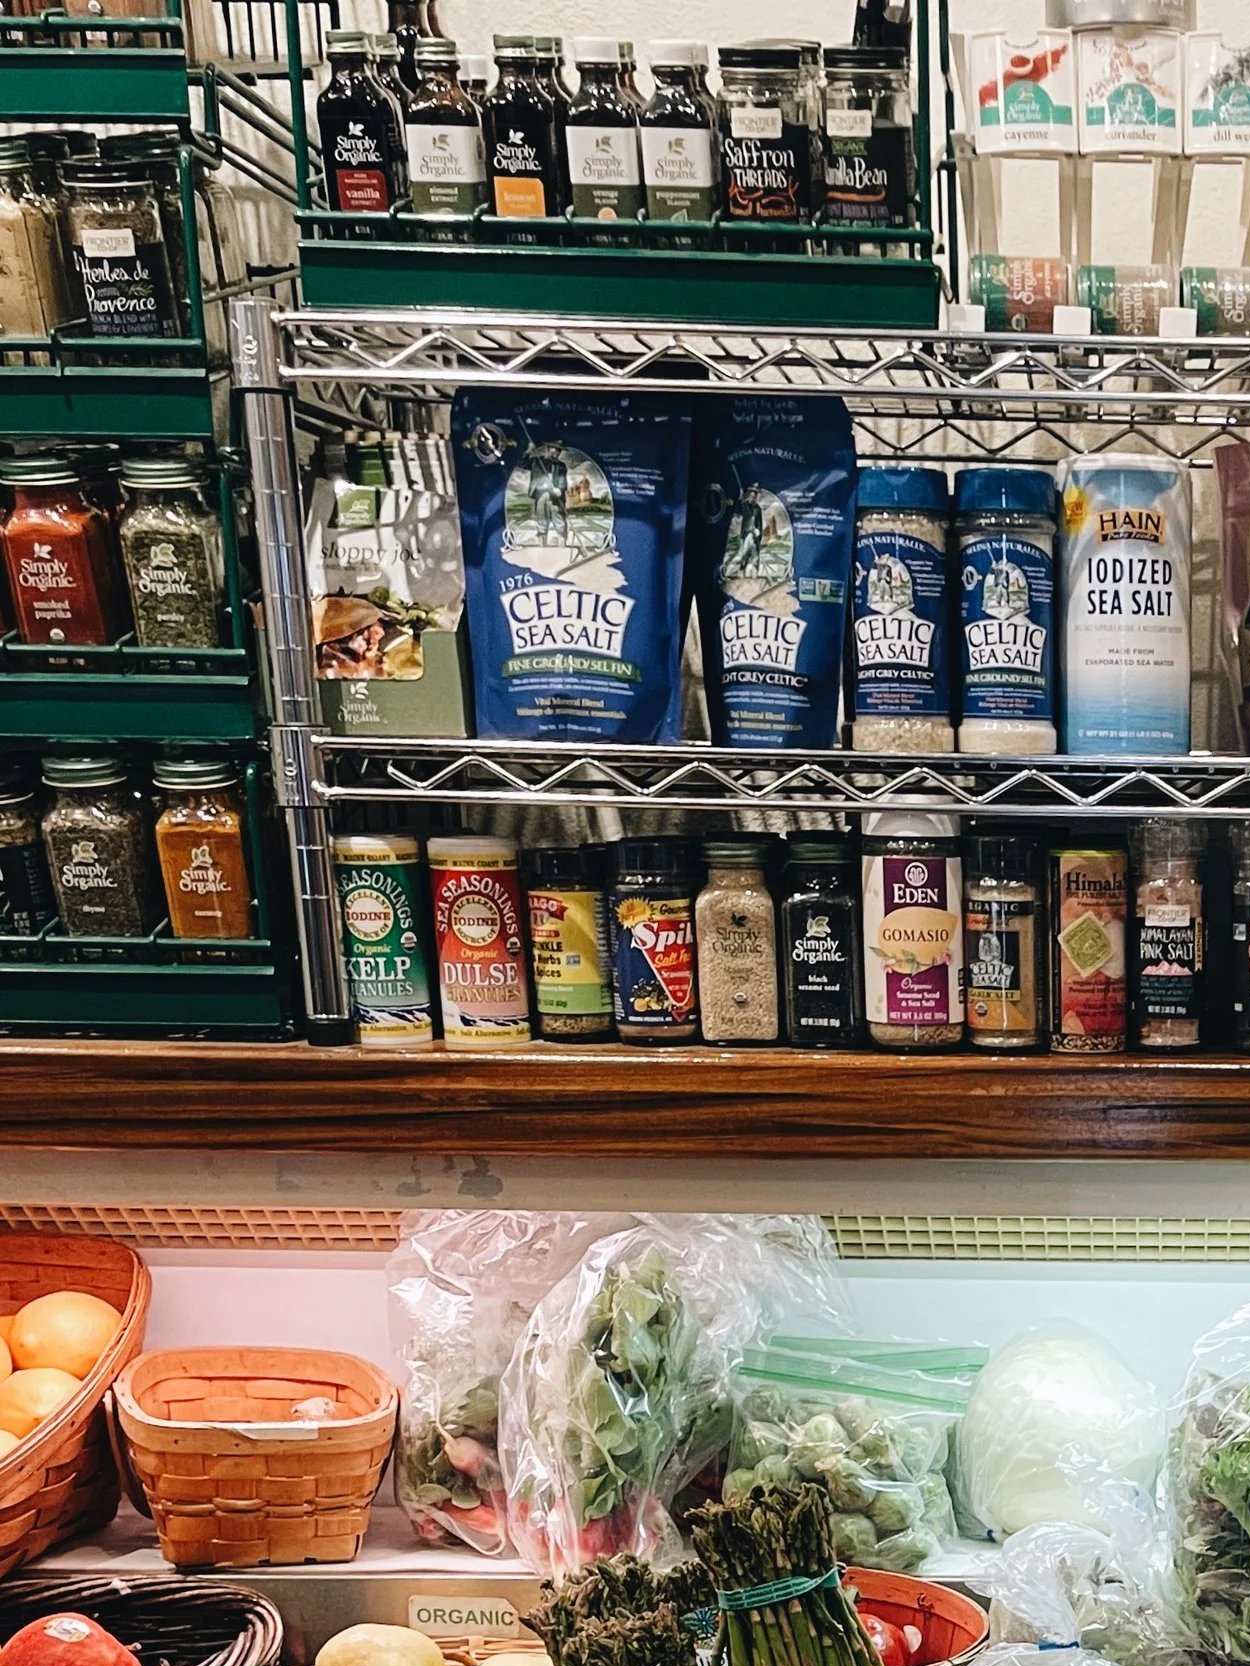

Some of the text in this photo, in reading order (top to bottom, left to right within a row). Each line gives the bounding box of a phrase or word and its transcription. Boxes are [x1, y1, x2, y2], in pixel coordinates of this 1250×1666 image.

[337, 136, 376, 152] Simply
[1004, 129, 1049, 142] cayenne
[1213, 129, 1231, 142] dill
[496, 143, 535, 160] Simply
[724, 138, 795, 168] Saffron
[422, 153, 459, 170] Simply
[584, 155, 622, 171] Simply
[657, 156, 695, 171] Simply
[734, 169, 787, 188] THREADS
[854, 157, 887, 189] Bean
[346, 189, 380, 200] vanilla
[79, 256, 152, 283] Herbes de
[84, 284, 157, 313] Provence
[1100, 511, 1160, 533] HAIN
[20, 560, 68, 575] Simply
[140, 567, 187, 583] Simply
[1088, 558, 1172, 585] IODIZED
[19, 572, 76, 592] Organic
[138, 580, 196, 597] Organic
[500, 573, 533, 592] 1976
[509, 589, 626, 627] CELTIC
[1087, 590, 1173, 617] SEA SALT
[516, 624, 619, 650] SEA SALT
[722, 614, 800, 645] CELTIC
[857, 618, 931, 644] CELTIC
[967, 622, 1043, 650] CELTIC
[725, 643, 794, 666] SEA SALT
[860, 643, 927, 663] SEA SALT
[971, 649, 1039, 668] SEA SALT
[63, 864, 109, 878] Simply
[180, 869, 222, 883] Simply
[62, 875, 117, 890] Organic
[893, 883, 939, 904] EDEN
[442, 874, 518, 934] SEASONINGS
[346, 911, 391, 921] IODINE
[454, 917, 498, 927] IODINE
[716, 927, 761, 943] Simply
[882, 928, 949, 943] GOMASIO
[1140, 928, 1194, 942] HIMALAYAN
[353, 943, 392, 953] Organic
[461, 948, 497, 958] Organic
[795, 938, 839, 952] Simply
[1140, 943, 1193, 960] PINK SALT
[792, 950, 846, 964] Organic
[343, 957, 411, 981] KELP
[442, 961, 518, 985] DULSE
[417, 1608, 514, 1626] ORGANIC
